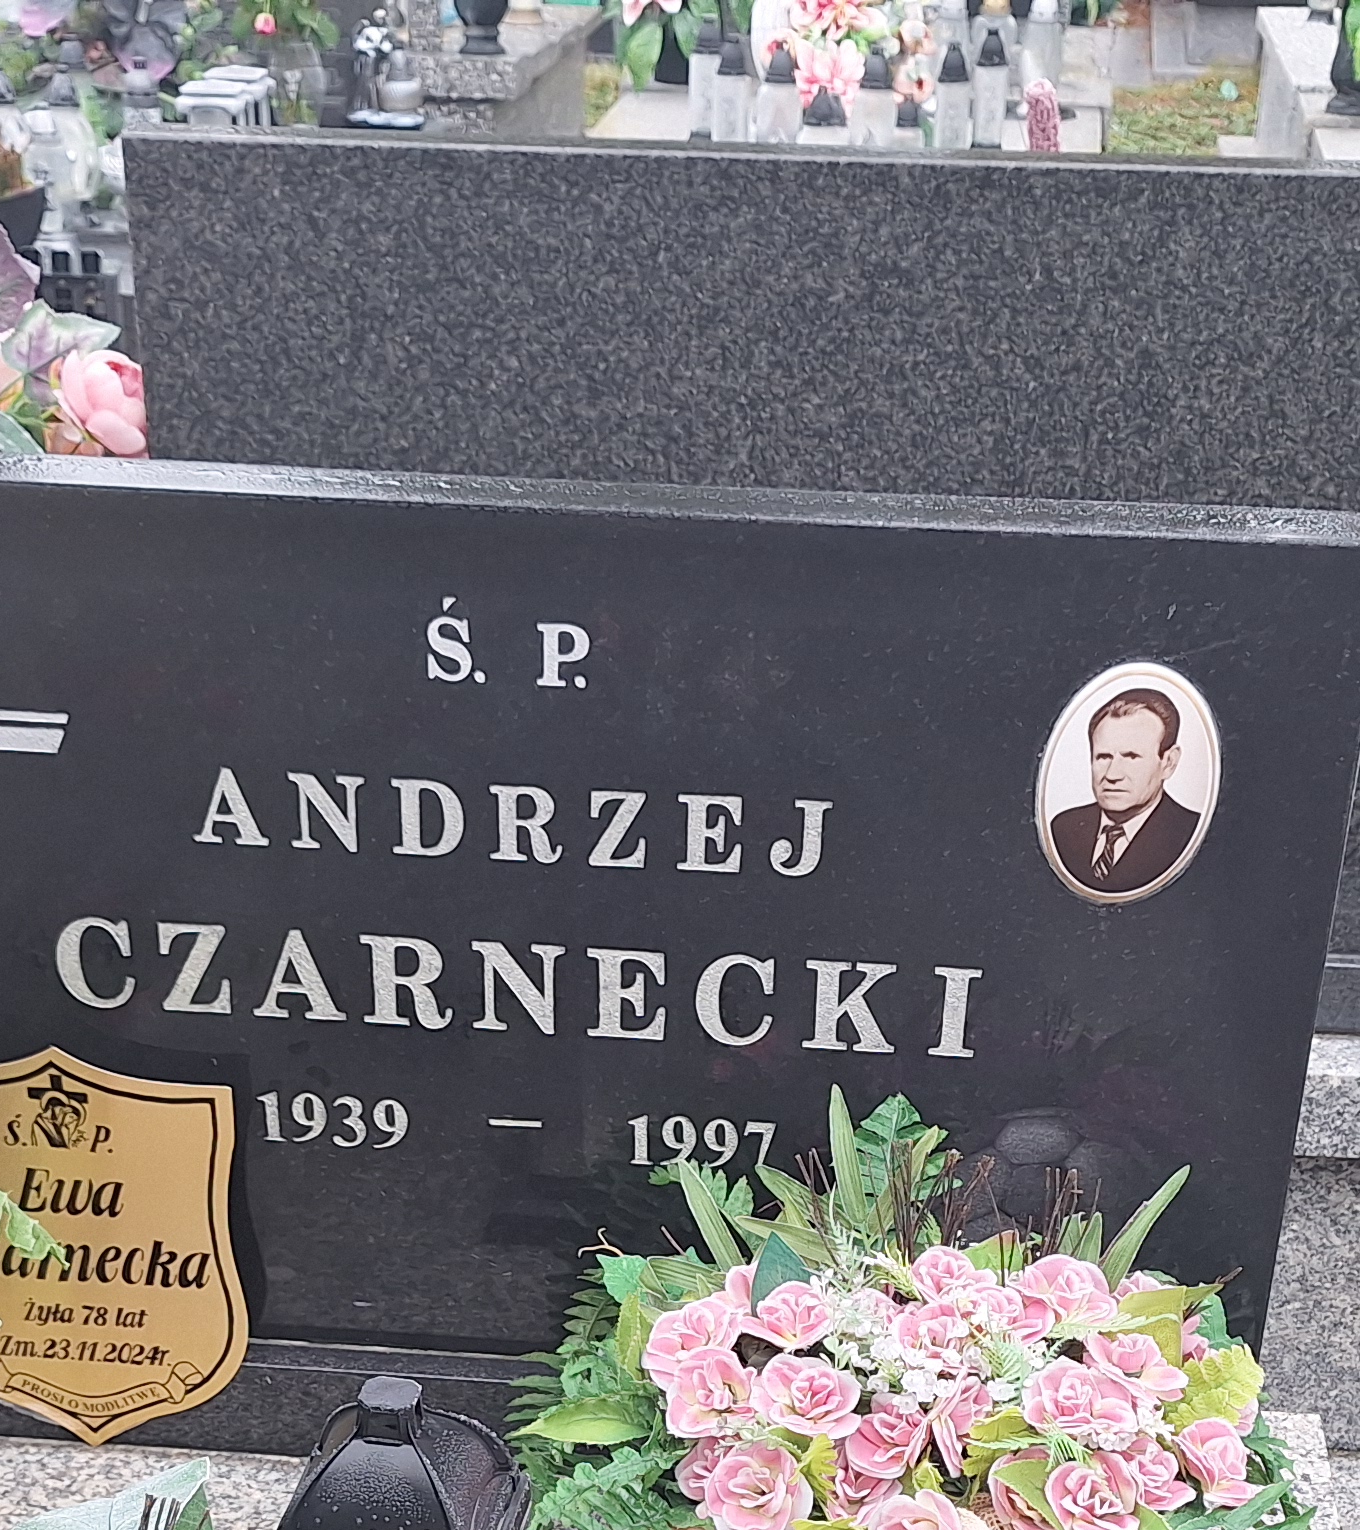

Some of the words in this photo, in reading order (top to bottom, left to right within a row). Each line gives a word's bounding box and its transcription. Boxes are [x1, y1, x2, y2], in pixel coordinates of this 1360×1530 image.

[426, 596, 486, 684] Ś.
[536, 621, 590, 689] P.
[193, 766, 833, 877] ANDRZEJ
[54, 916, 984, 1058] CZARNECKI
[4, 1113, 28, 1147] Ś.
[90, 1125, 114, 1154] P.
[256, 1091, 410, 1148] 1939
[627, 1114, 778, 1167] 1997
[19, 1167, 124, 1217] Ewa
[23, 1297, 75, 1327] Żyła
[82, 1305, 108, 1327] 78
[115, 1307, 149, 1328] lat
[21, 1379, 65, 1405] PROSI
[68, 1397, 79, 1409] O
[82, 1386, 160, 1413] MODLITWĘ
